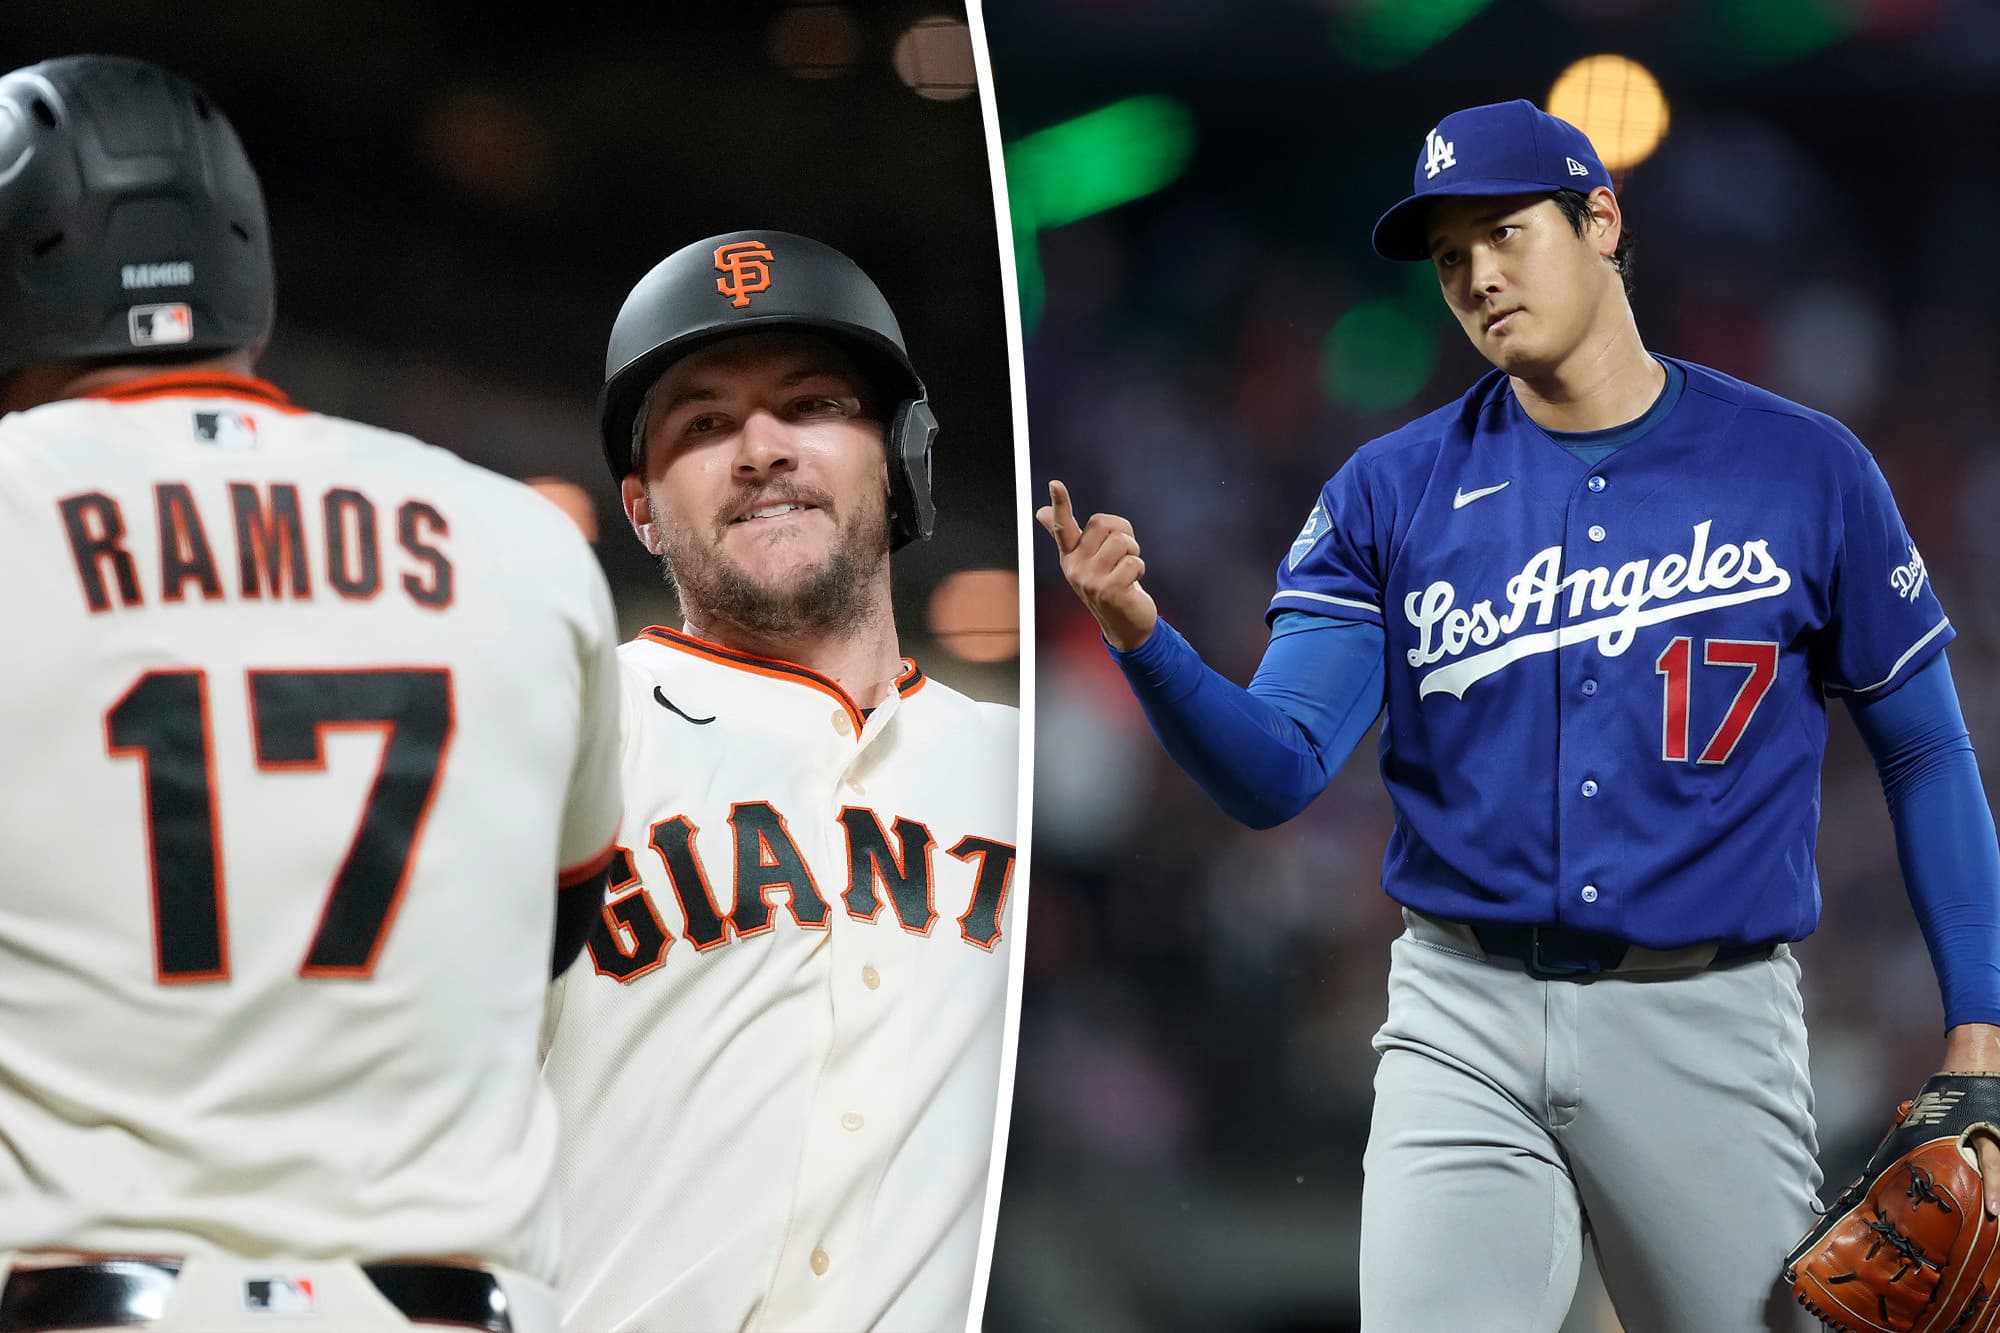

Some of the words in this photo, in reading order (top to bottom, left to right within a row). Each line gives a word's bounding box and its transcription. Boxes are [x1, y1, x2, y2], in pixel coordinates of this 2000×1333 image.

[1424, 127, 1457, 180] LA
[121, 261, 194, 289] RAMOS
[713, 240, 775, 309] SF
[56, 481, 456, 615] RAMOS
[1404, 580, 1502, 668] Los
[1499, 519, 1792, 658] Angeles
[1655, 636, 1780, 766] 17
[104, 667, 458, 987] 17
